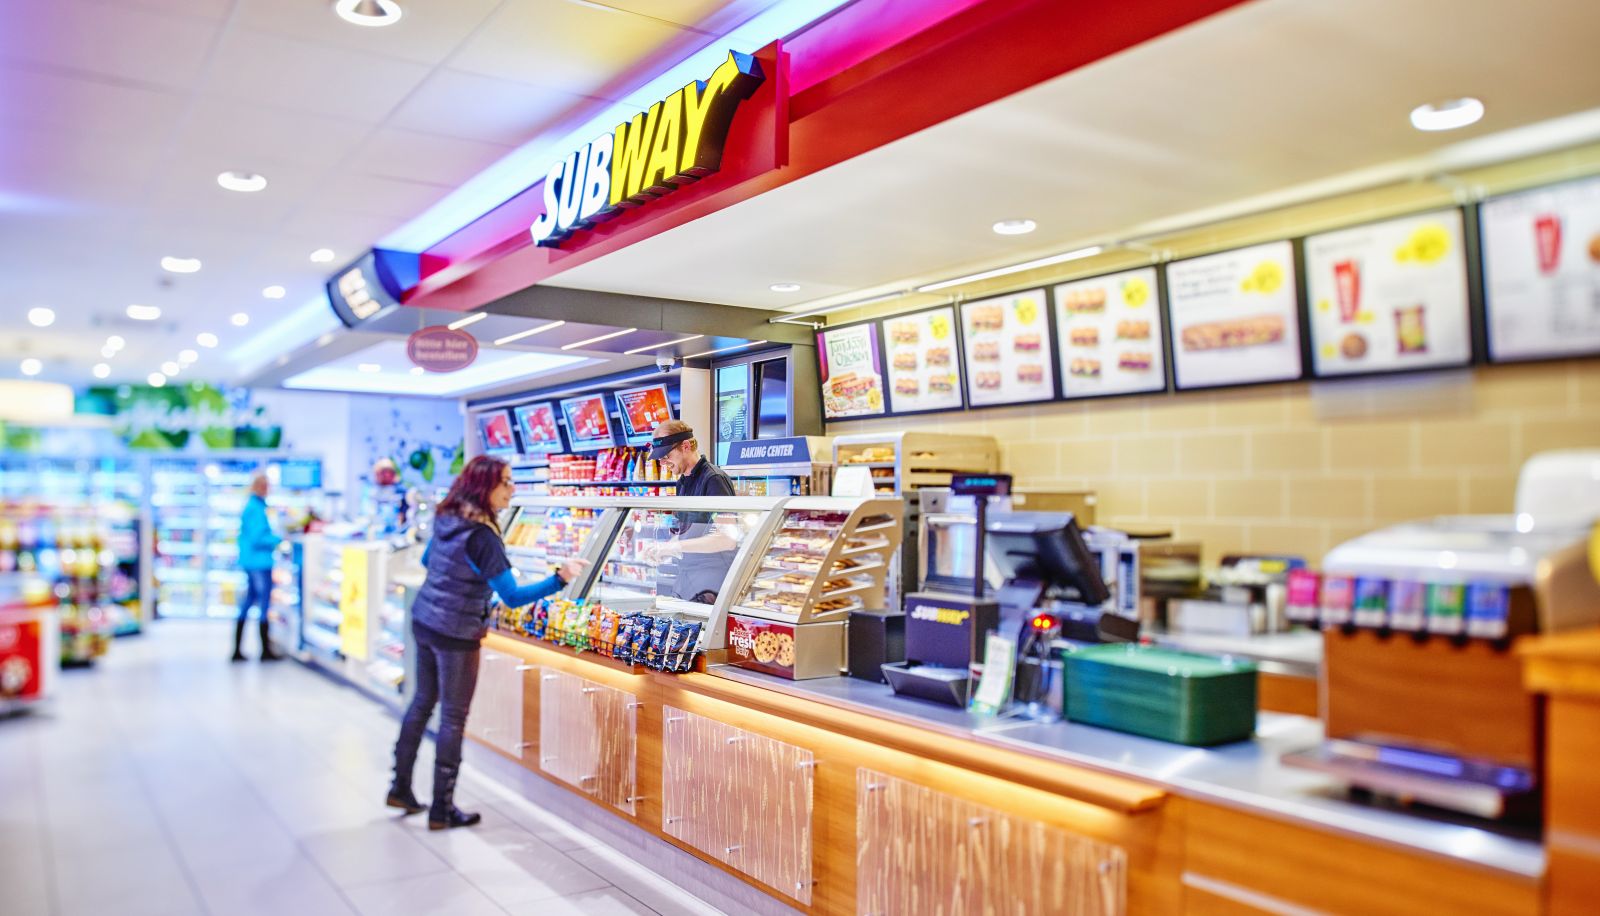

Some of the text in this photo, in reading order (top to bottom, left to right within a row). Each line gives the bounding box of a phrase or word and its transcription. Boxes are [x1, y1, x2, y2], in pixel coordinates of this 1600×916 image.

[530, 49, 750, 247] SUBWAY
[740, 444, 793, 458] BAKING CENTER
[729, 631, 755, 649] Fresh
